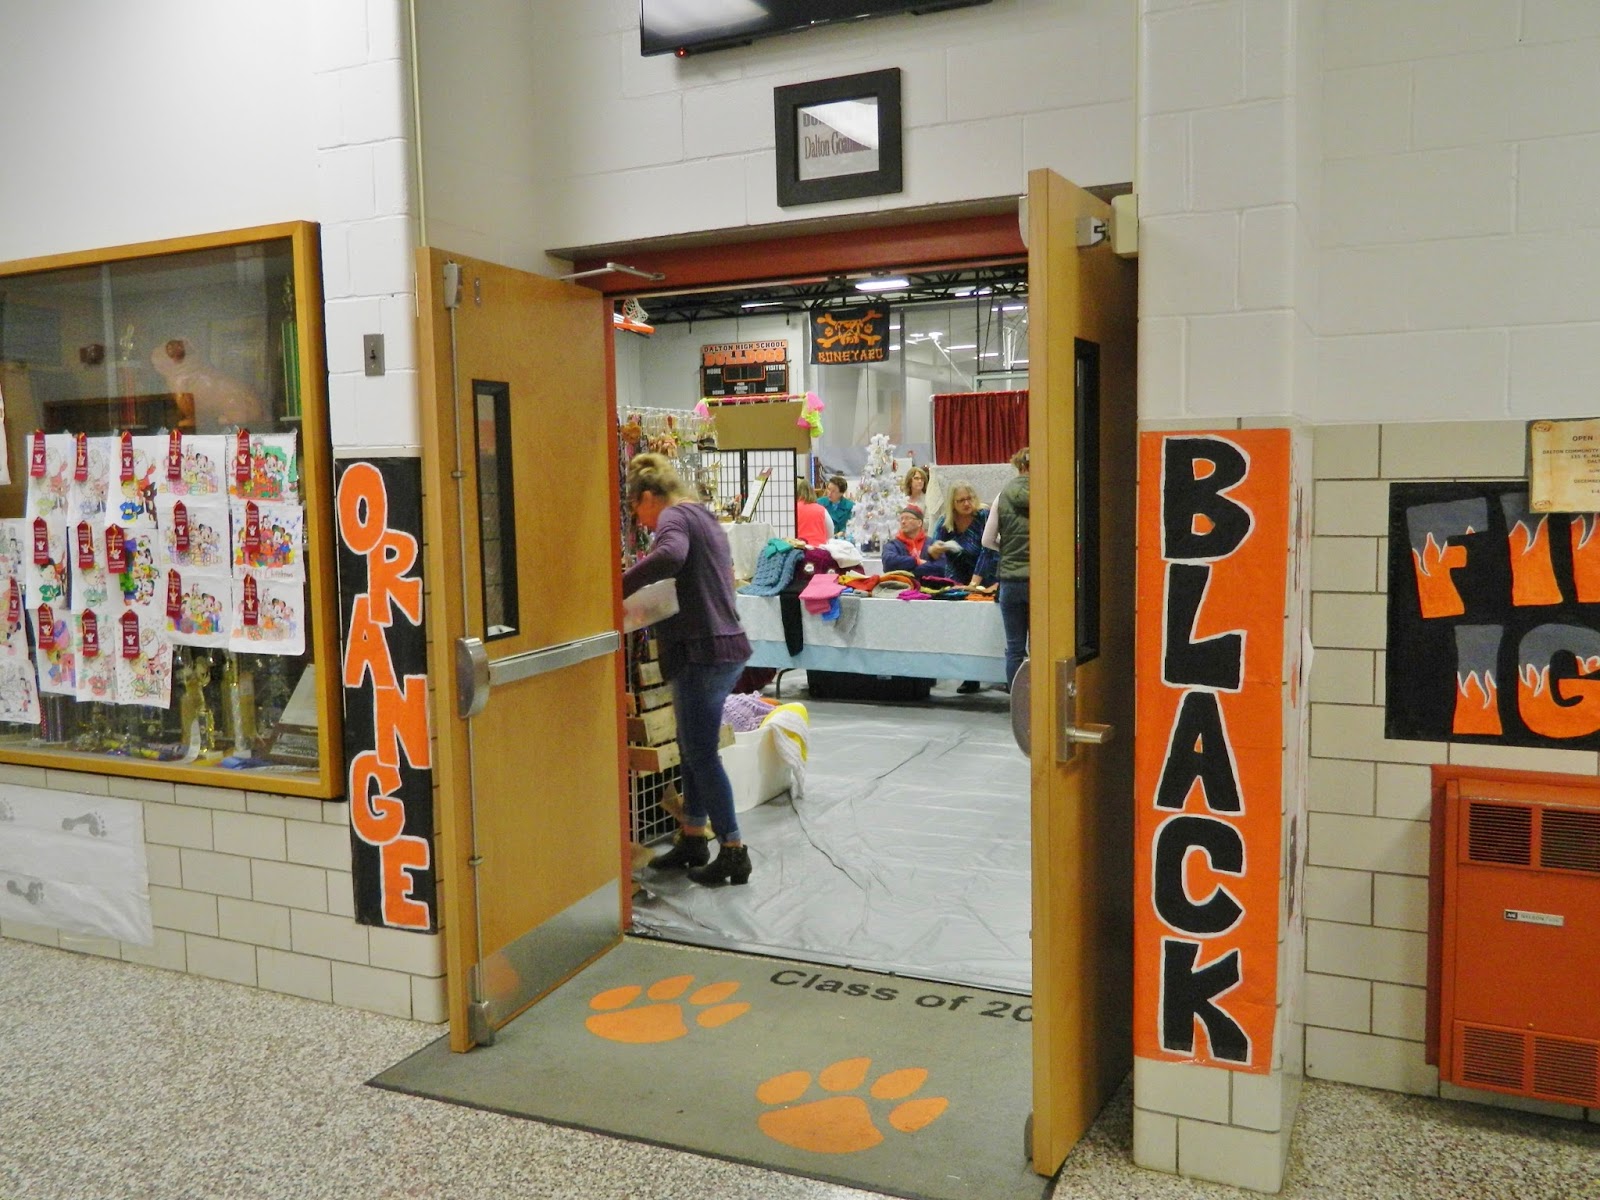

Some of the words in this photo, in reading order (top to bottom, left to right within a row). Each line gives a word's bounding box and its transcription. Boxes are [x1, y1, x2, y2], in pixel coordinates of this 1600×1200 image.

[804, 133, 830, 159] Dalton
[704, 345, 734, 353] DALTON
[735, 343, 754, 351] HIGH
[755, 341, 785, 349] SCHOOL
[704, 347, 786, 367] BULLDOGS
[818, 348, 884, 363] BONEYARD
[337, 461, 431, 931] ORANGE
[1152, 435, 1254, 1067] BLACK
[769, 969, 900, 1002] Class
[914, 994, 975, 1012] of
